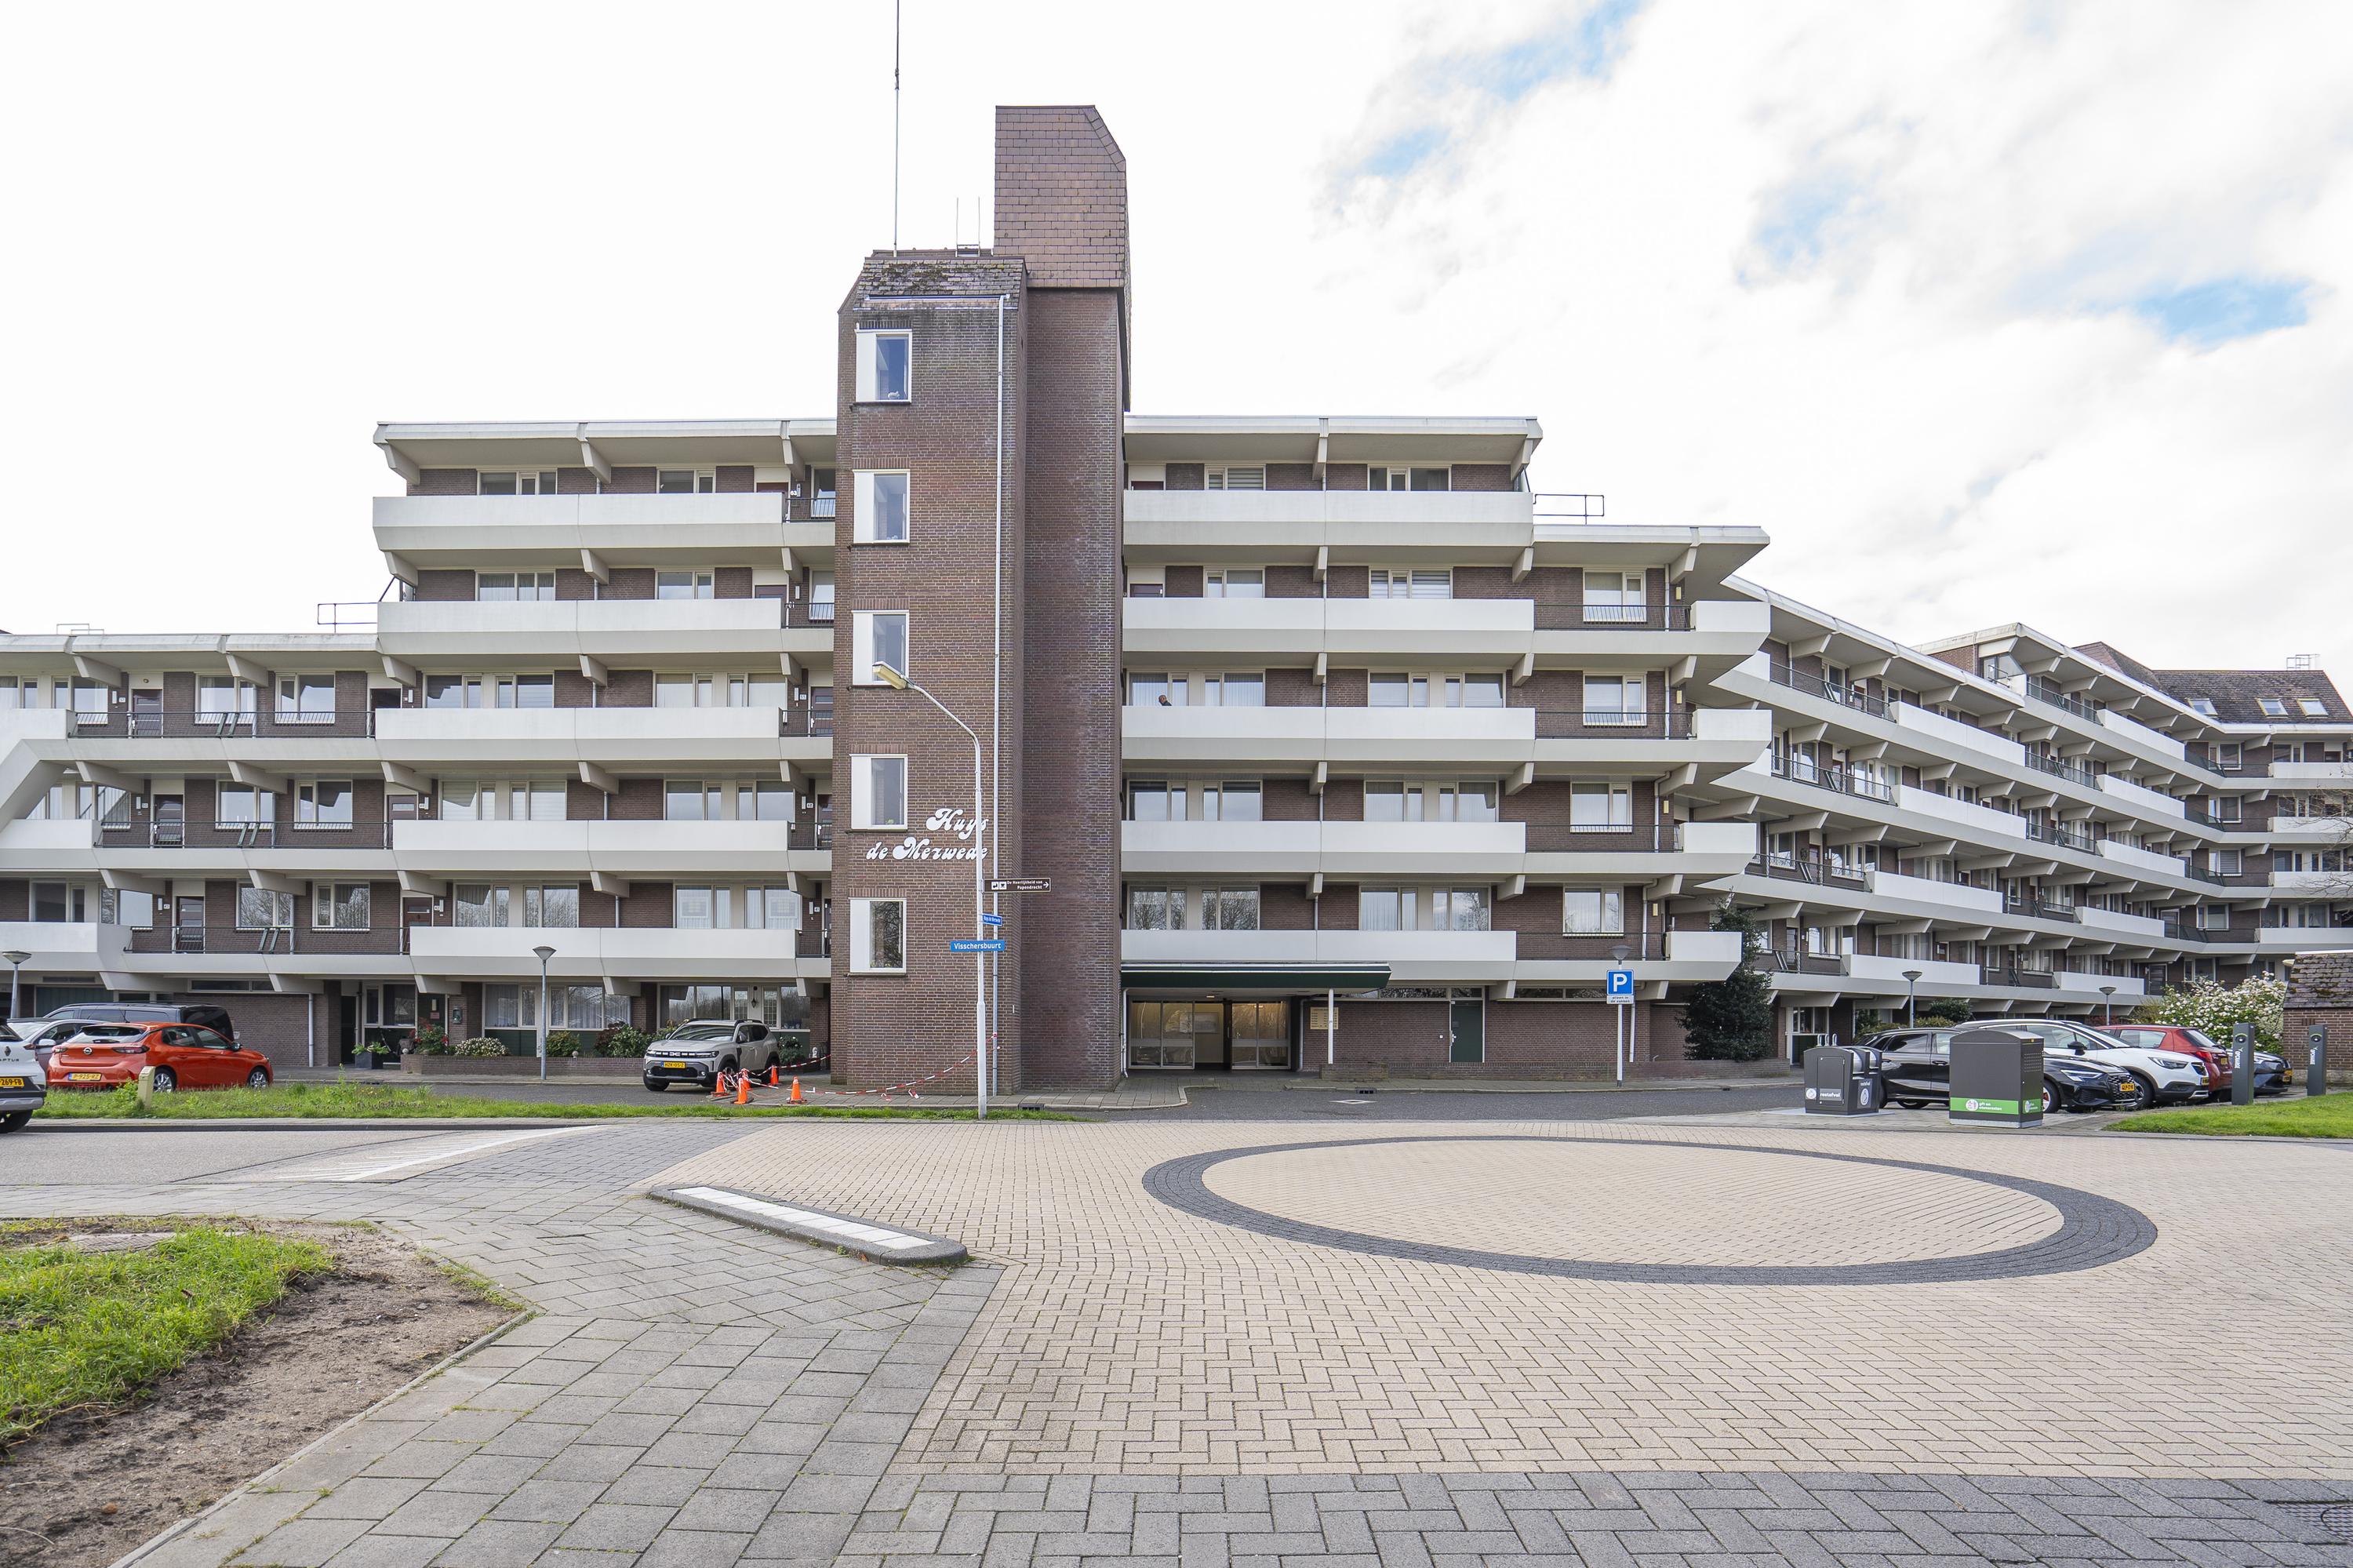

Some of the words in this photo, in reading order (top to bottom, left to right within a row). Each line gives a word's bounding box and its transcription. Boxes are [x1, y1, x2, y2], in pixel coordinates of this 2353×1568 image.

[926, 808, 989, 840] Huys
[866, 842, 889, 860] de
[892, 836, 989, 860] Merwede
[1613, 973, 1627, 992] P
